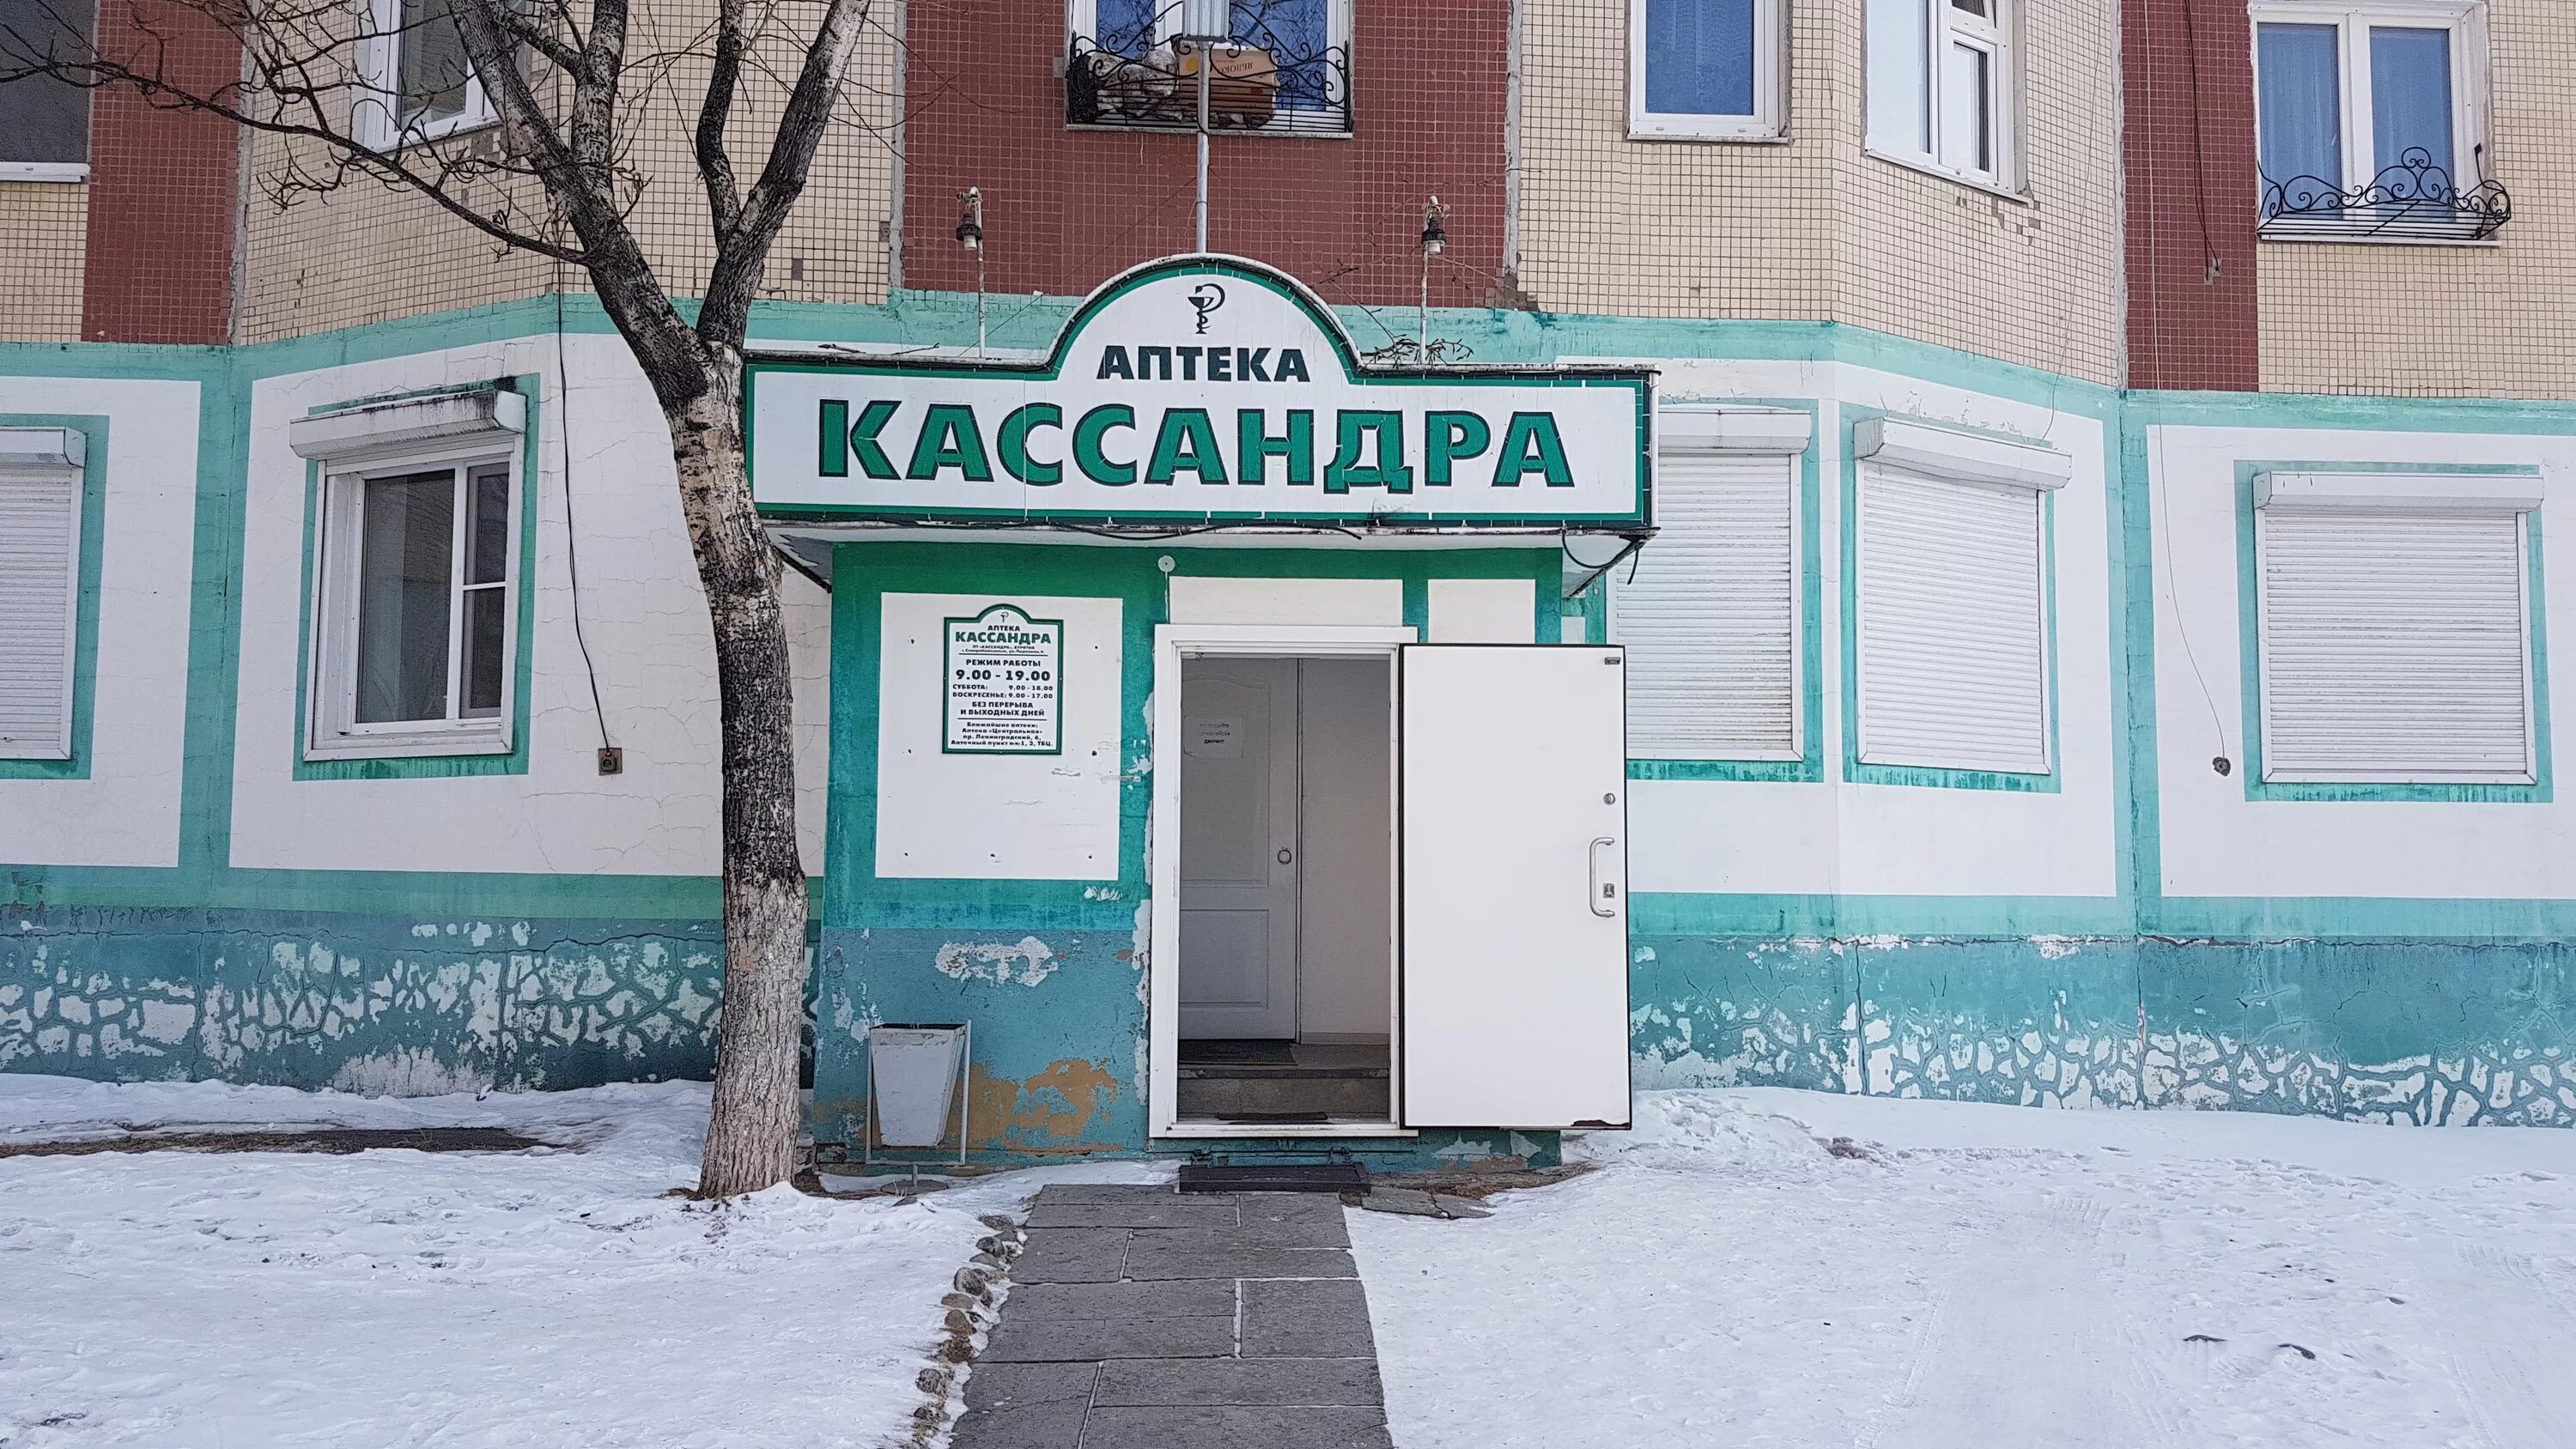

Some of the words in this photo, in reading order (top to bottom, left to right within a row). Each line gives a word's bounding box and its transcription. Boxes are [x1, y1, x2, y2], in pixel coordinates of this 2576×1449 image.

[1097, 344, 1310, 383] АПТЕКА
[818, 399, 1575, 495] КАССАНДРА
[955, 631, 1051, 645] КАССАНДРА
[956, 670, 992, 680] 9.00
[1005, 670, 1051, 682] 19.00
[1021, 708, 1045, 717] ДНЕЙ
